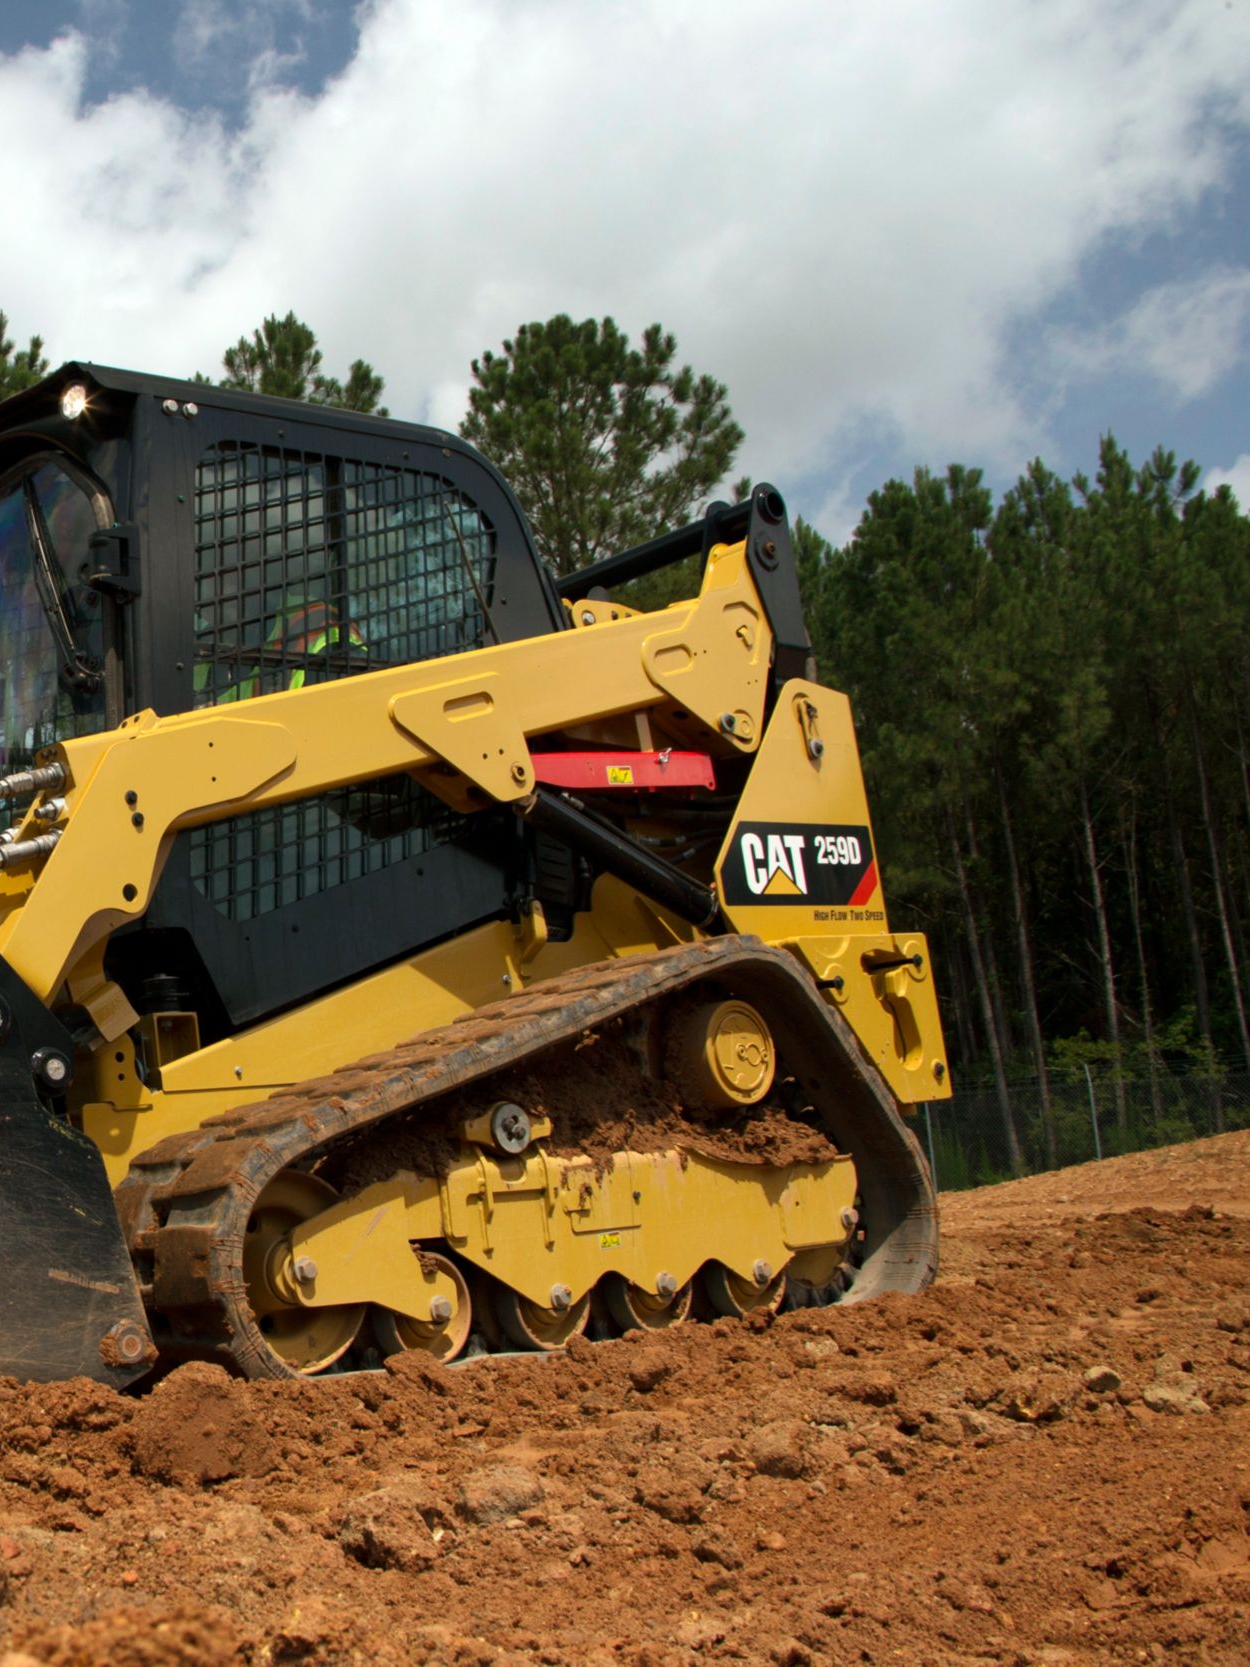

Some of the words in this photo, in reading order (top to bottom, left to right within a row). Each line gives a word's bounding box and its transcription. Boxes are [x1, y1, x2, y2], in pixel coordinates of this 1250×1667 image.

[741, 832, 808, 895] CAT
[814, 836, 862, 865] 259D
[814, 909, 830, 921] HIGH
[830, 909, 847, 921] FLOW
[850, 909, 864, 921] TWO
[865, 909, 884, 921] SPEED
